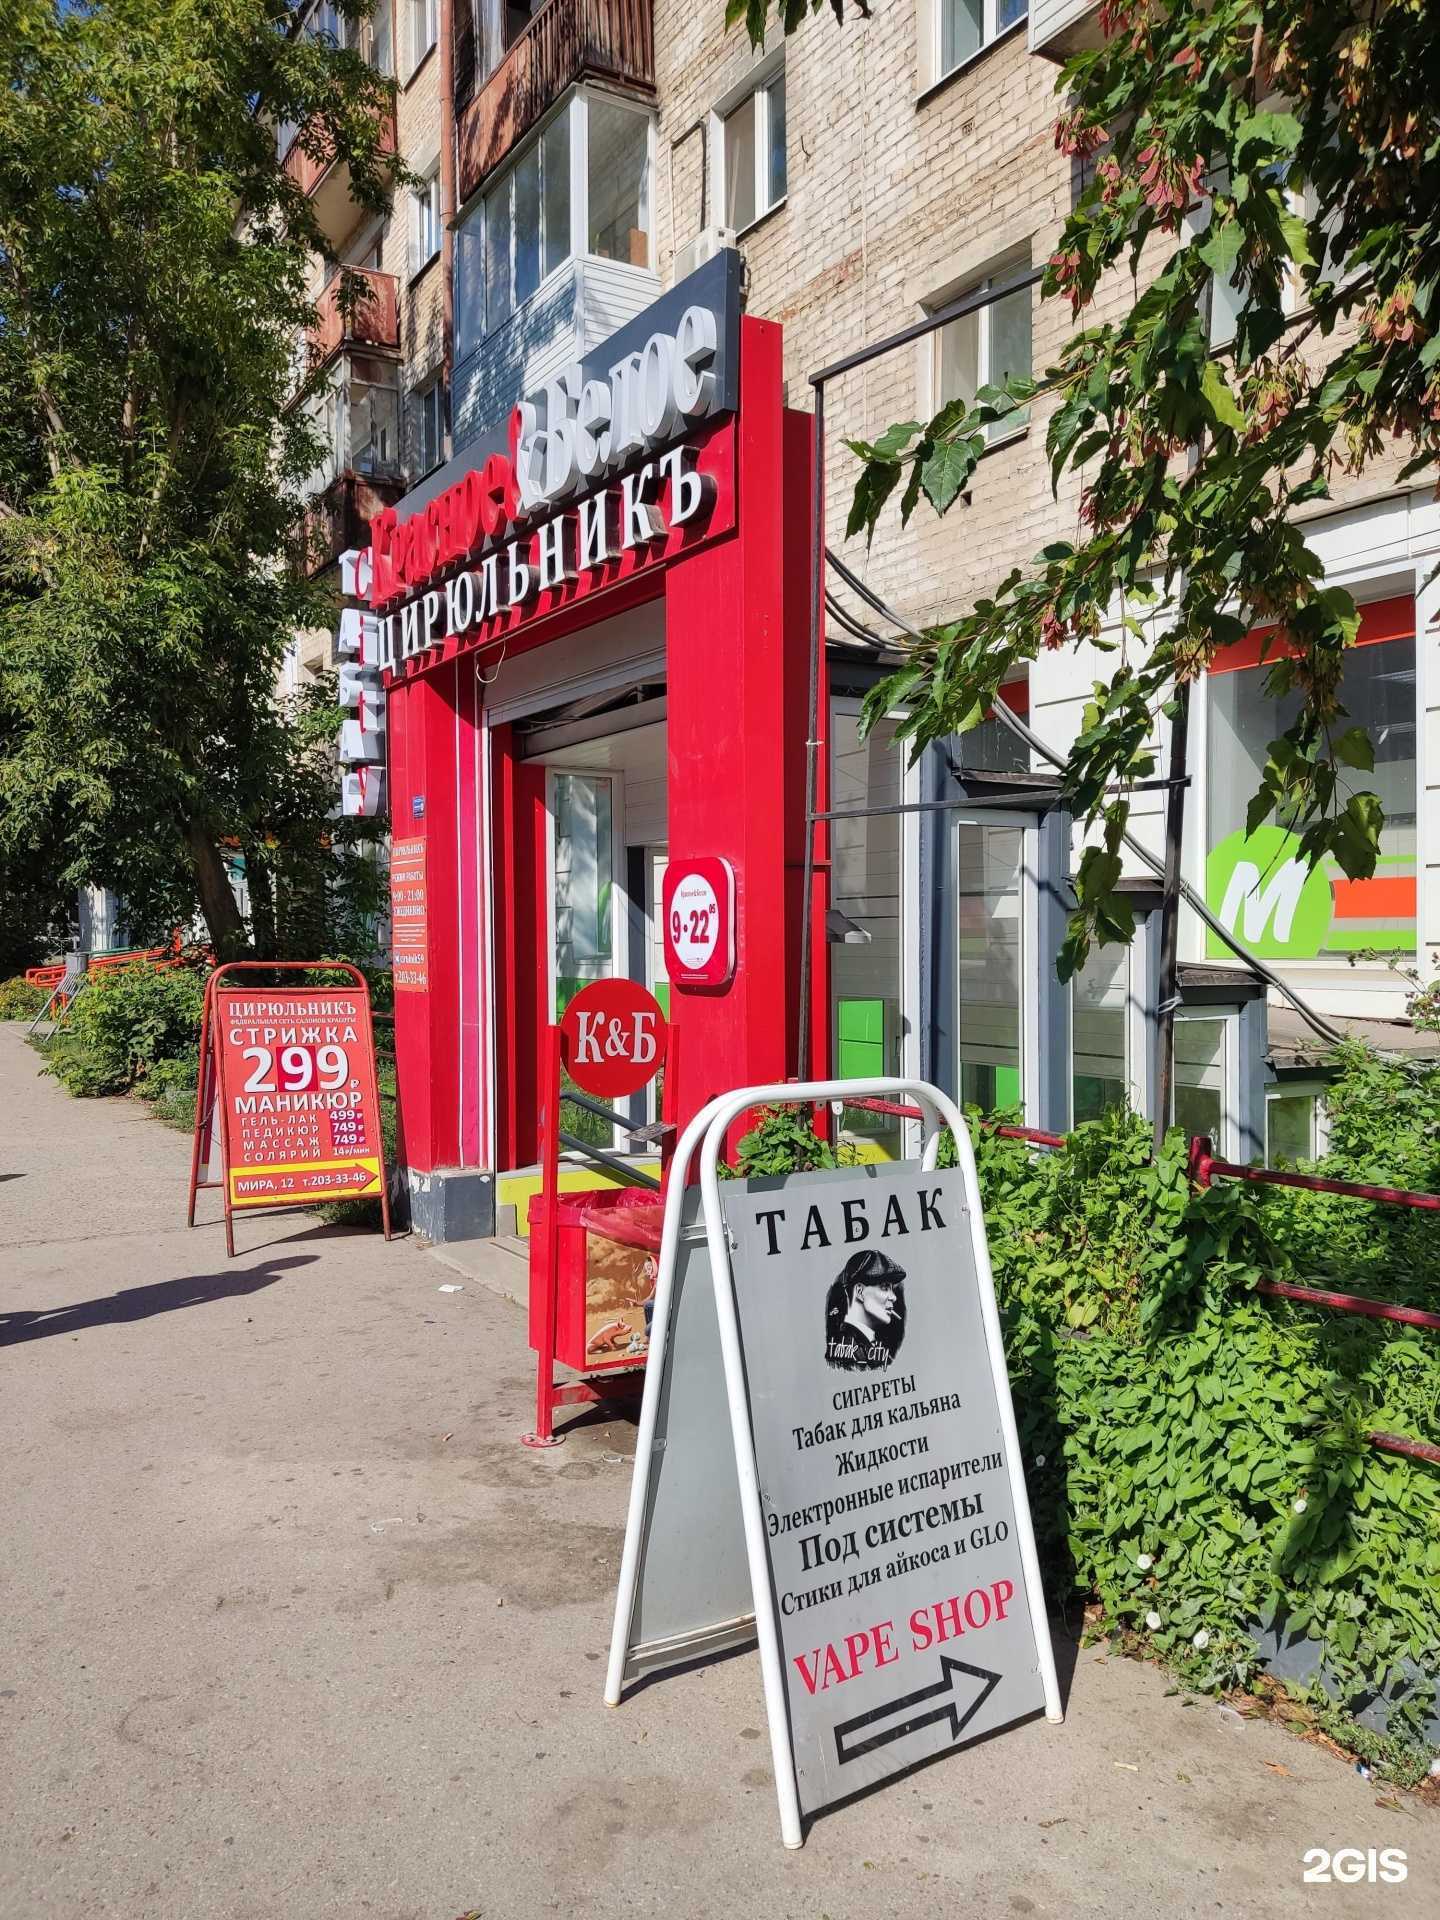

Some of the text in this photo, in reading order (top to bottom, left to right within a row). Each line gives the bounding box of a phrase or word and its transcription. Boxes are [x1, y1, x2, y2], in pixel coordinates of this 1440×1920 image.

[377, 445, 707, 676] ЦИРЮЛЬНИКЪ
[229, 1001, 357, 1018] ЦИРЮЛЬНИКЪ
[229, 1025, 358, 1046] СТРИЖКА
[574, 1011, 657, 1063] К&Б
[242, 1045, 350, 1093] 299
[235, 1091, 363, 1115] МАНИКЮР
[241, 1114, 318, 1126] ГЕЛЬ-ЛАК
[329, 1110, 355, 1121] 499
[242, 1125, 320, 1138] ПЕДИКЮР
[332, 1121, 356, 1133] 749
[243, 1137, 321, 1150] МАССАЖ
[333, 1134, 357, 1145] 749
[244, 1147, 321, 1162] СОЛЯРИЙ
[238, 1179, 278, 1192] МИРА,
[281, 1178, 295, 1188] 12
[755, 1187, 947, 1256] ТАБАК
[832, 1374, 917, 1411] СИГАРЕТЫ
[792, 1392, 962, 1452] Табак для кальяна
[835, 1434, 930, 1477] Жидкости
[767, 1450, 1004, 1537] Электронные испарители
[798, 1492, 985, 1572] Под системы
[781, 1520, 1010, 1616] Стики для айкоса и GLO
[792, 1579, 1015, 1697] VAPE SHOP
